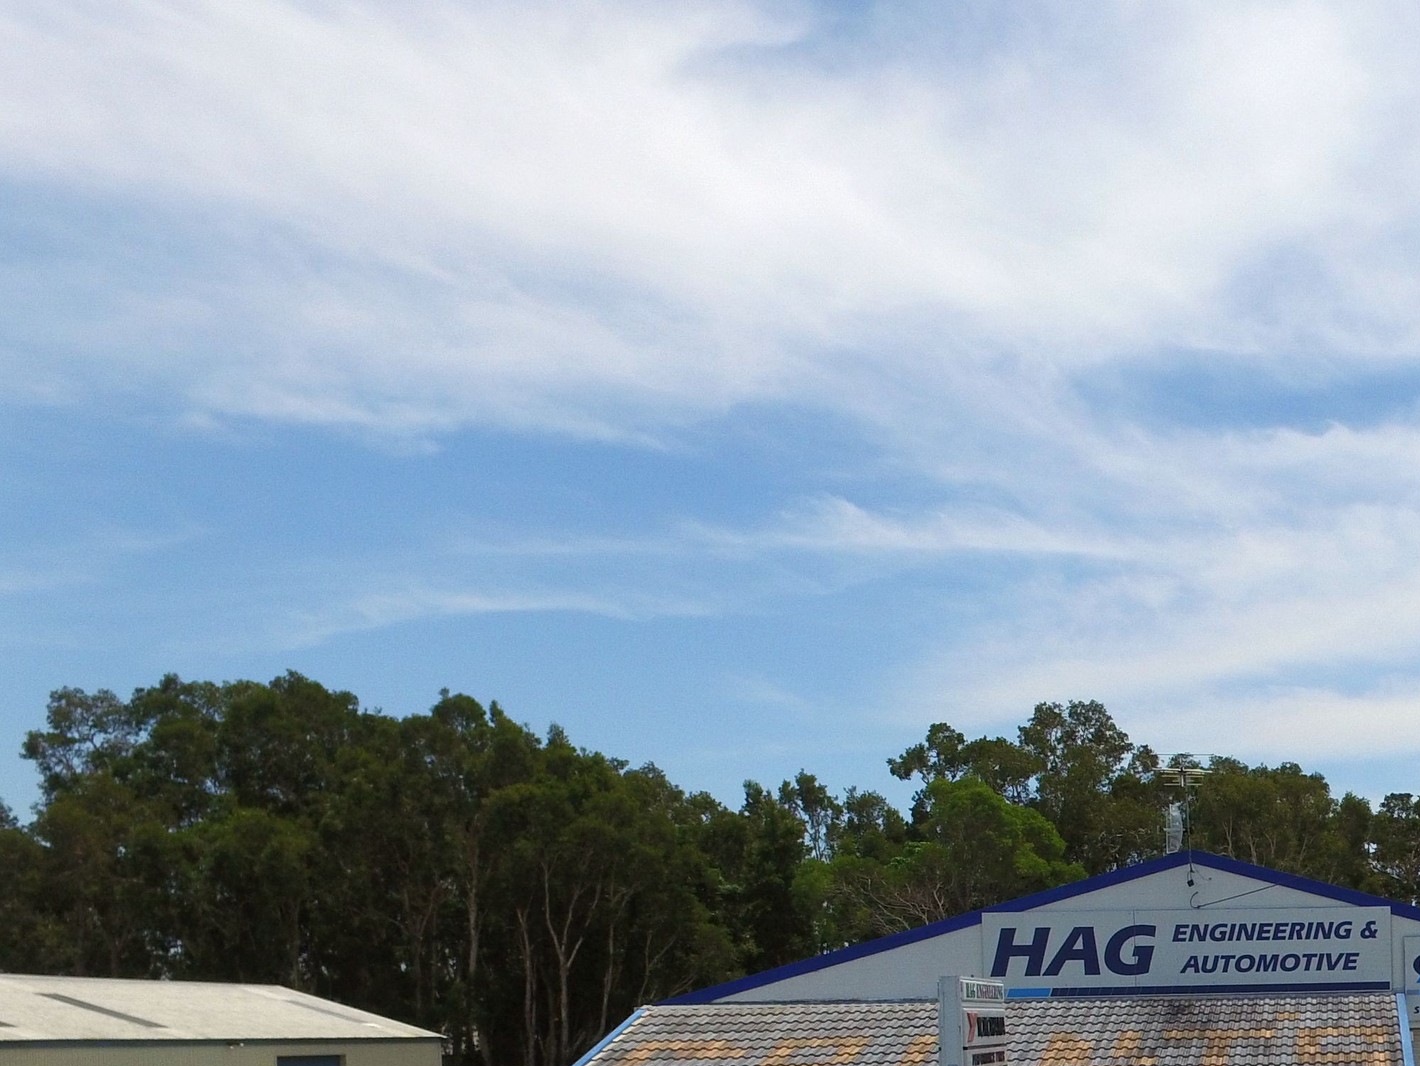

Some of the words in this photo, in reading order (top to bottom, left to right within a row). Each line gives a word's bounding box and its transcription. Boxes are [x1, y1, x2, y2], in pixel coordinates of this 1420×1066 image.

[1172, 922, 1353, 942] ENGINEERING
[1360, 920, 1378, 939] &
[990, 925, 1156, 977] HAG
[1180, 952, 1359, 973] AUTOMOTIVE
